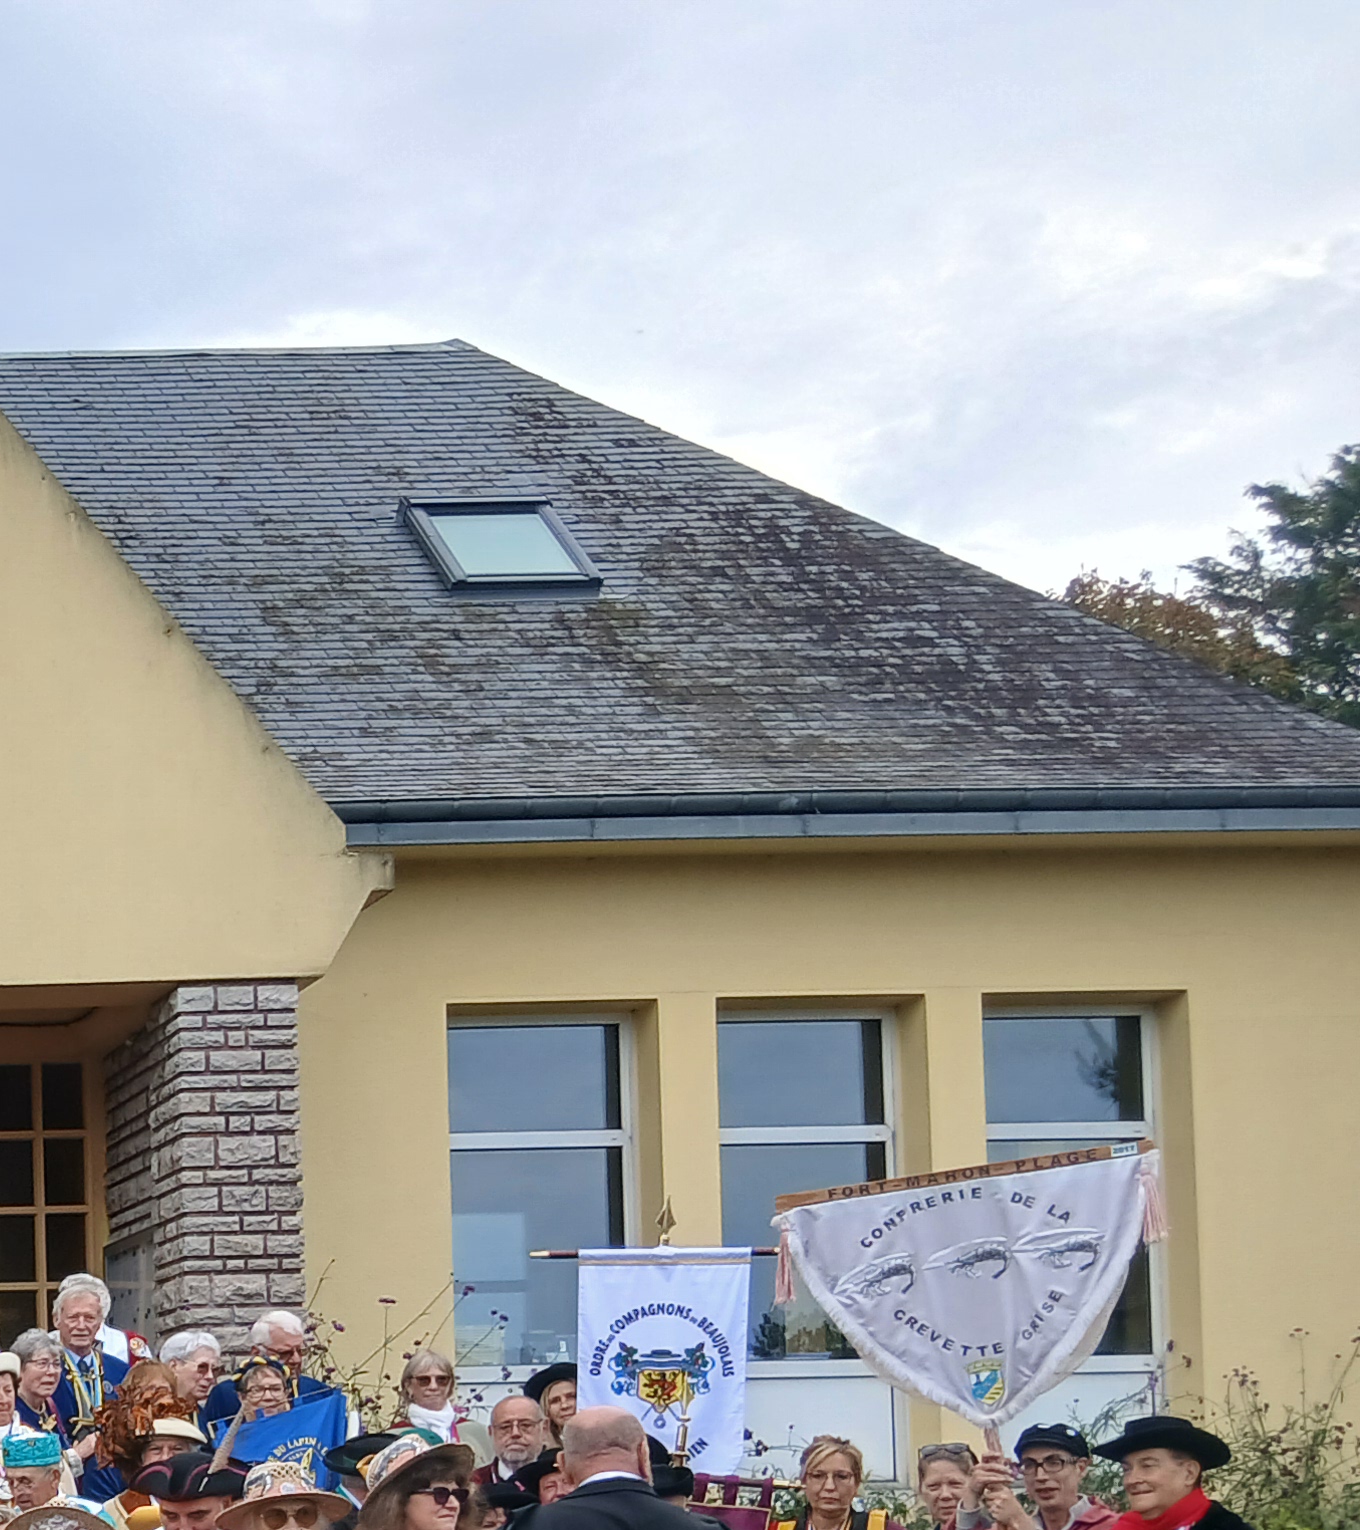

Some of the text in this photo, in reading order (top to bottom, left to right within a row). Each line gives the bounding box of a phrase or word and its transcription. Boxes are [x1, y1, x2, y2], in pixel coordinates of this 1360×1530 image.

[1010, 1192, 1034, 1209] DE
[1046, 1204, 1070, 1224] LA
[589, 1338, 611, 1377] ORDRE
[609, 1303, 693, 1334] COMPAGNONS
[697, 1316, 735, 1378] BEAUJOLAIS
[893, 1289, 1063, 1357] CREVETTE GRISE
